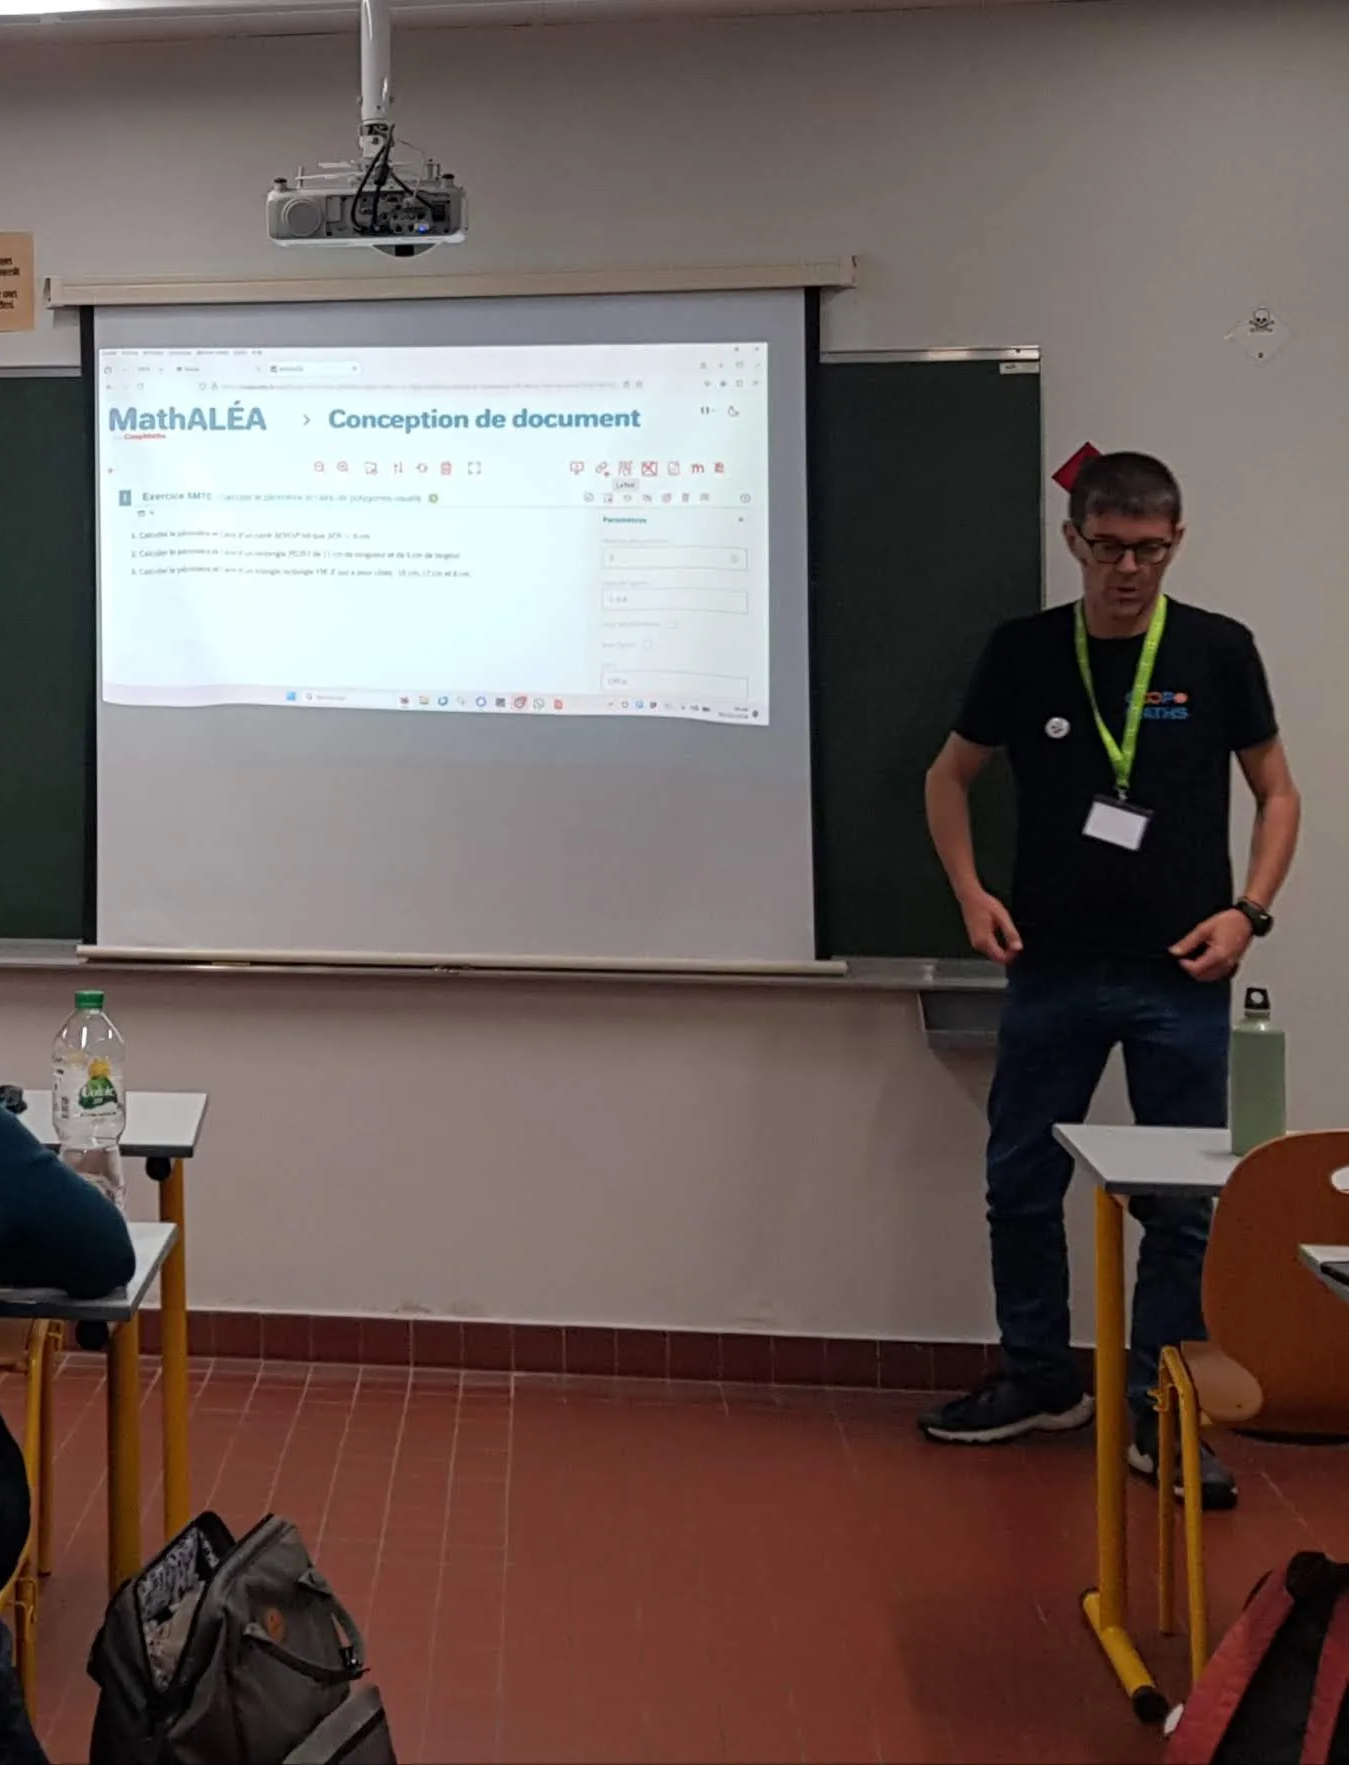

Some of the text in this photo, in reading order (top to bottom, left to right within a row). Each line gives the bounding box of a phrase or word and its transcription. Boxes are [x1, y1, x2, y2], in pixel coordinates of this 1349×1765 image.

[109, 400, 267, 431] MathALÉA
[328, 408, 641, 435] Conception de document
